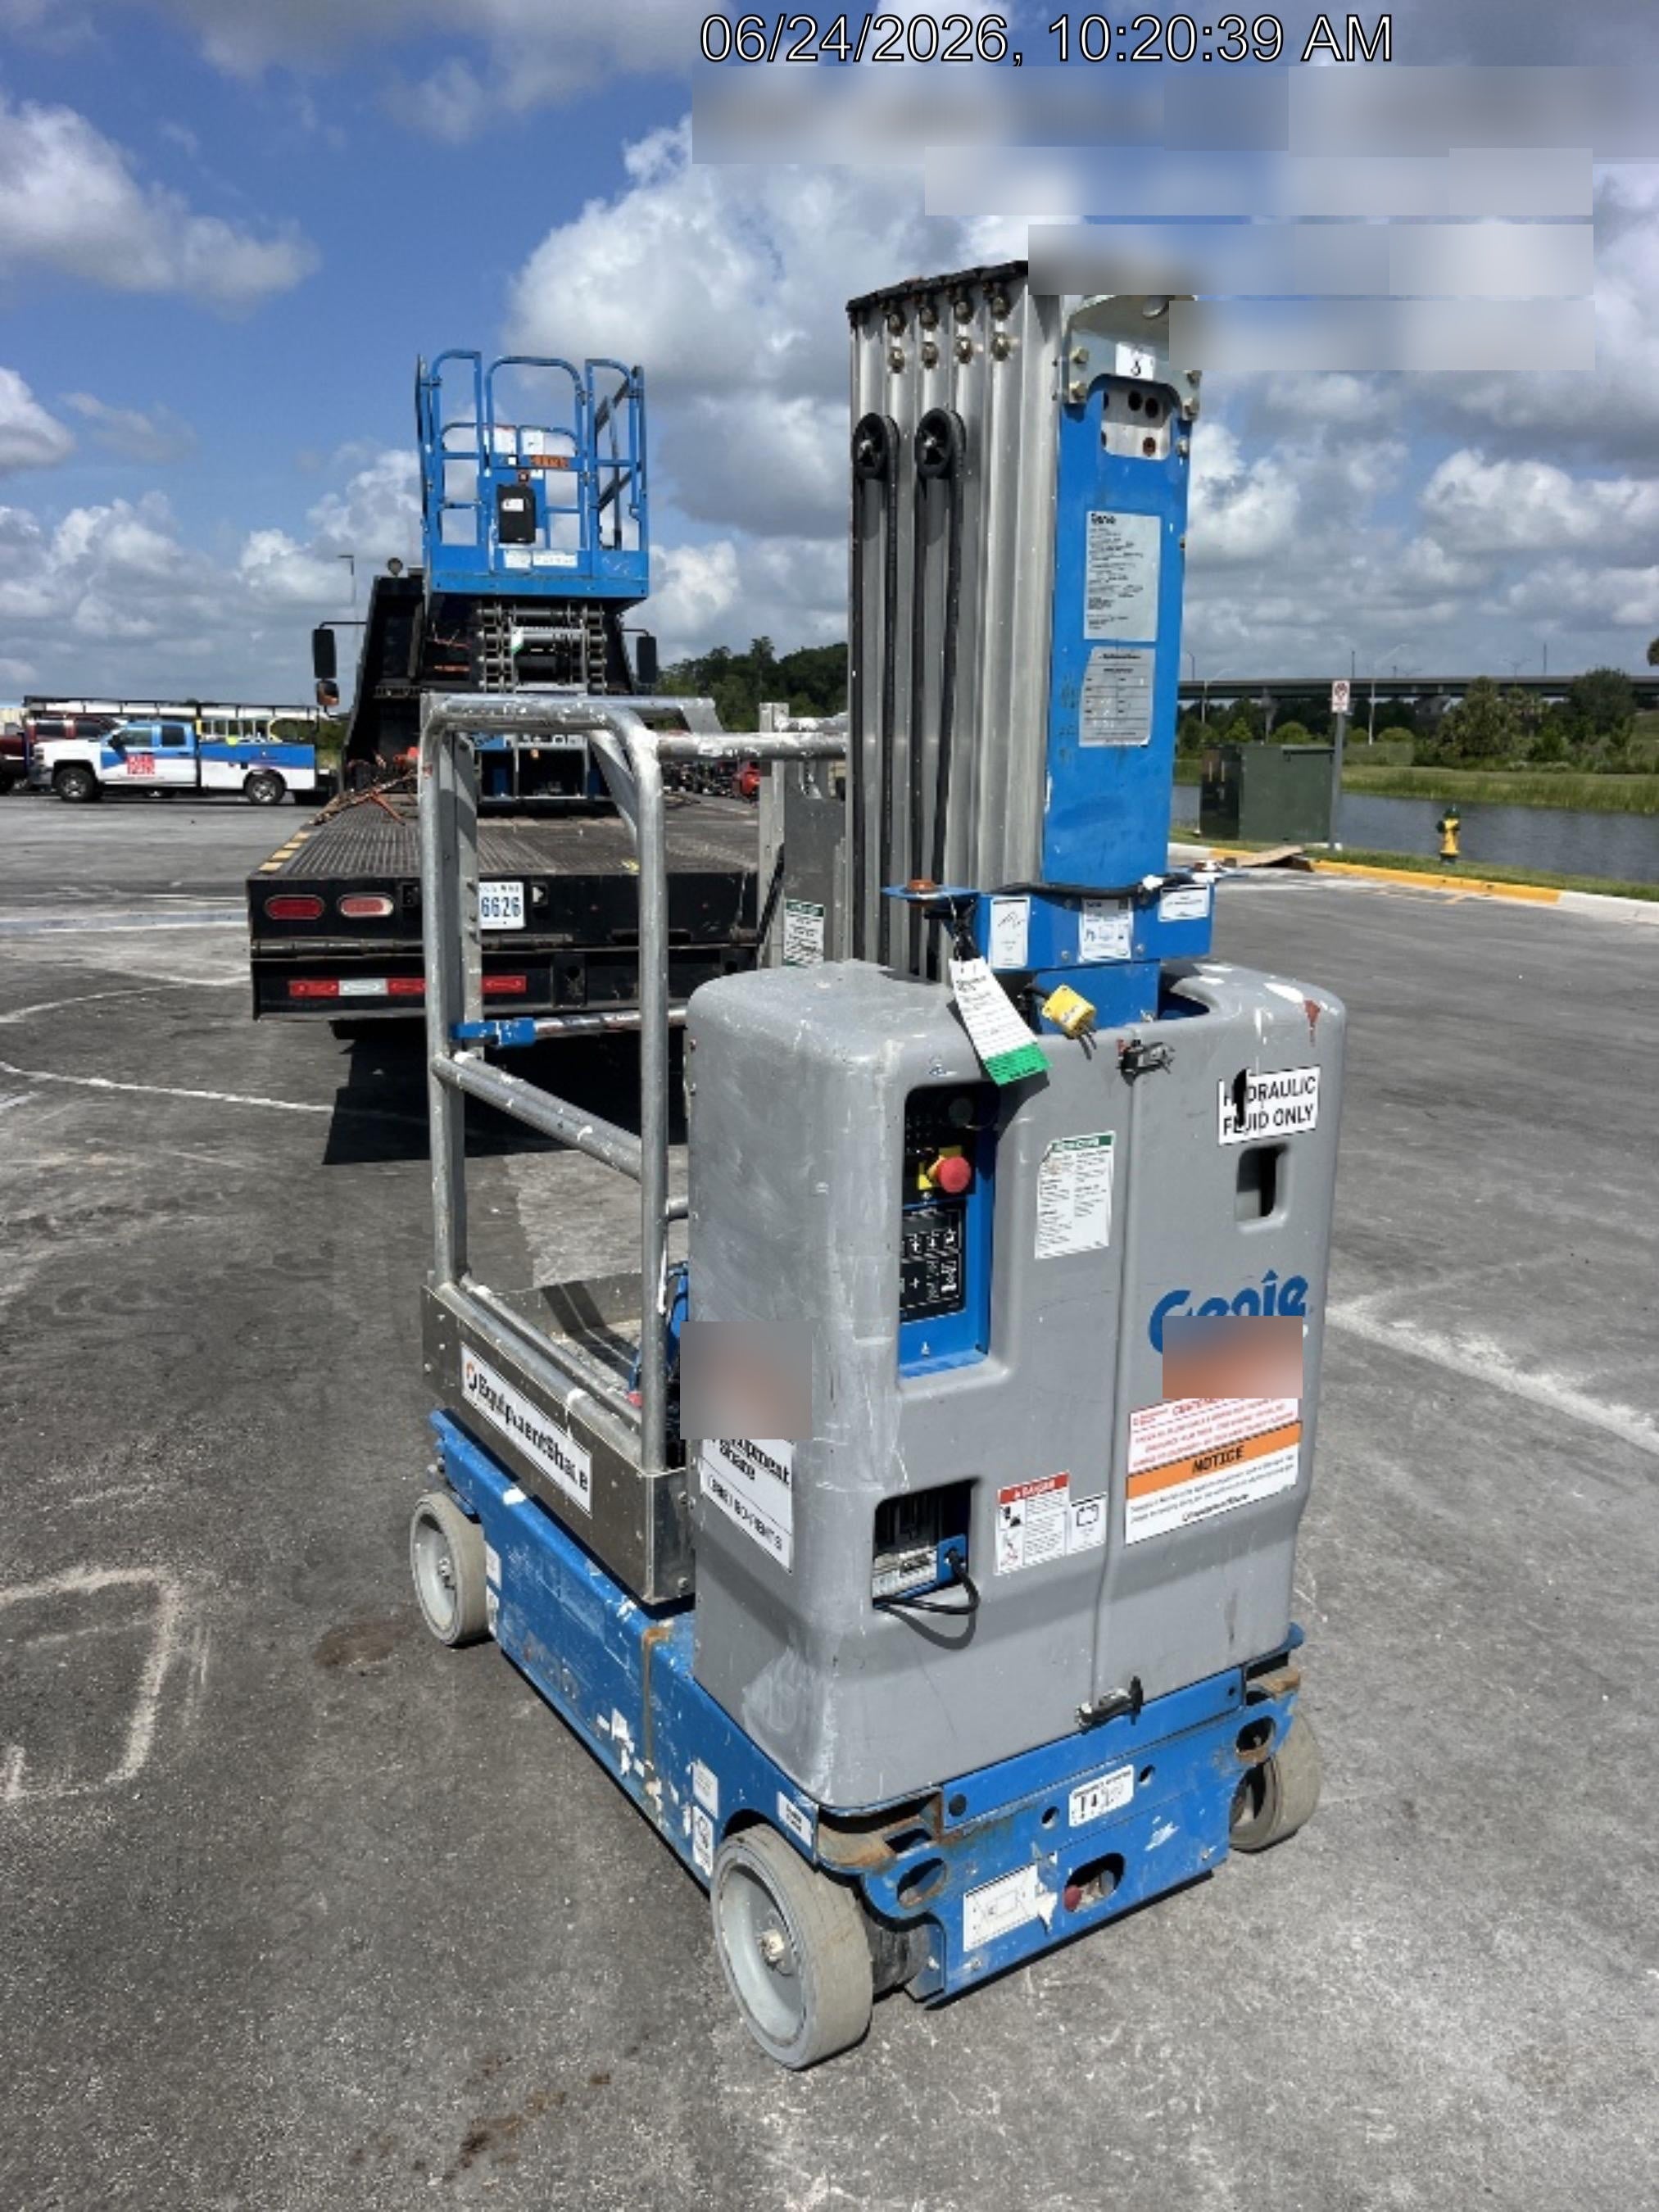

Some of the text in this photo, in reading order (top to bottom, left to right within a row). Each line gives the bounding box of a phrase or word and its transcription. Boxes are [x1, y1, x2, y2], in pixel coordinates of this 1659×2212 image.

[1224, 1076, 1317, 1106] DRAULIC
[1272, 1103, 1315, 1126] ONLY
[1191, 1445, 1245, 1474] NOTICE
